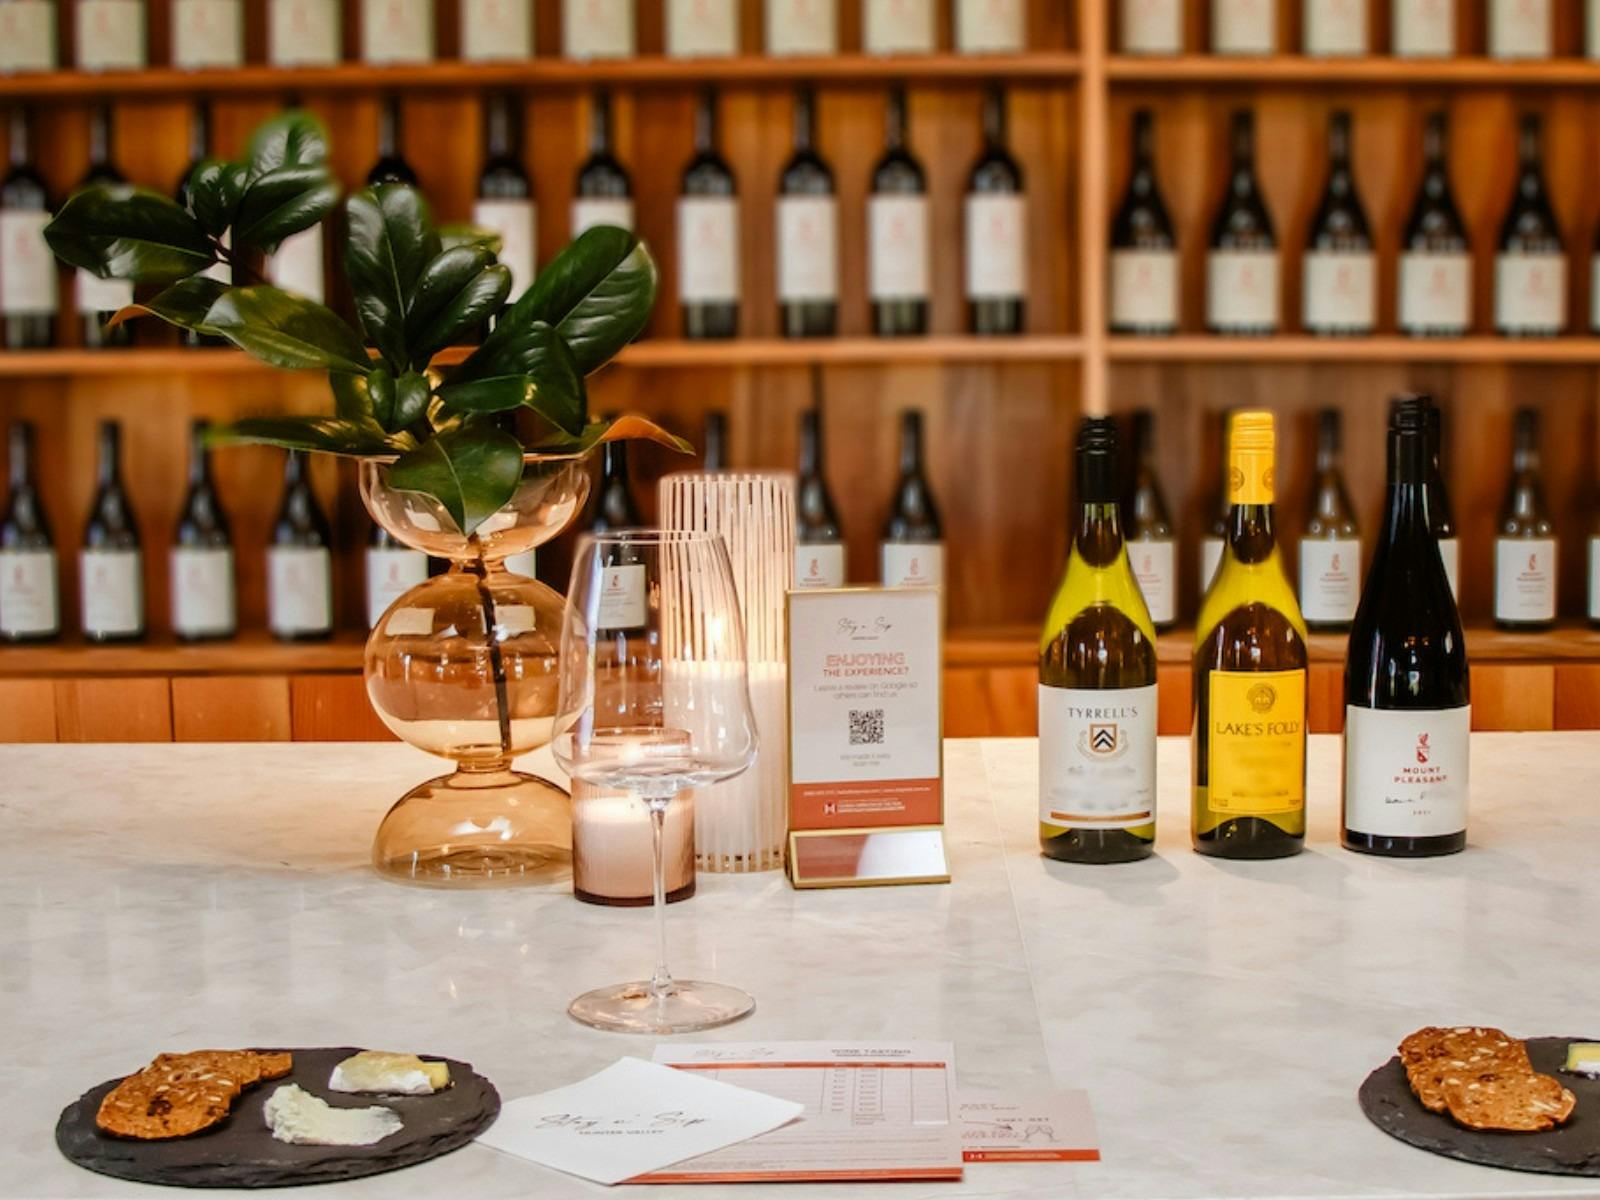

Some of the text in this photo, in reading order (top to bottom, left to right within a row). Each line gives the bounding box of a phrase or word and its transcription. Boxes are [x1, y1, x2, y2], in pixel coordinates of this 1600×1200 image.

[826, 652, 905, 667] ENJOYING
[823, 666, 910, 678] THE EXPERIENCE?
[881, 680, 907, 692] Google
[873, 689, 888, 698] find
[1068, 705, 1138, 719] TYRRELL'S
[1215, 721, 1264, 737] LAKE'S
[1402, 766, 1441, 775] MOUNT
[1393, 774, 1448, 784] PLEASANT
